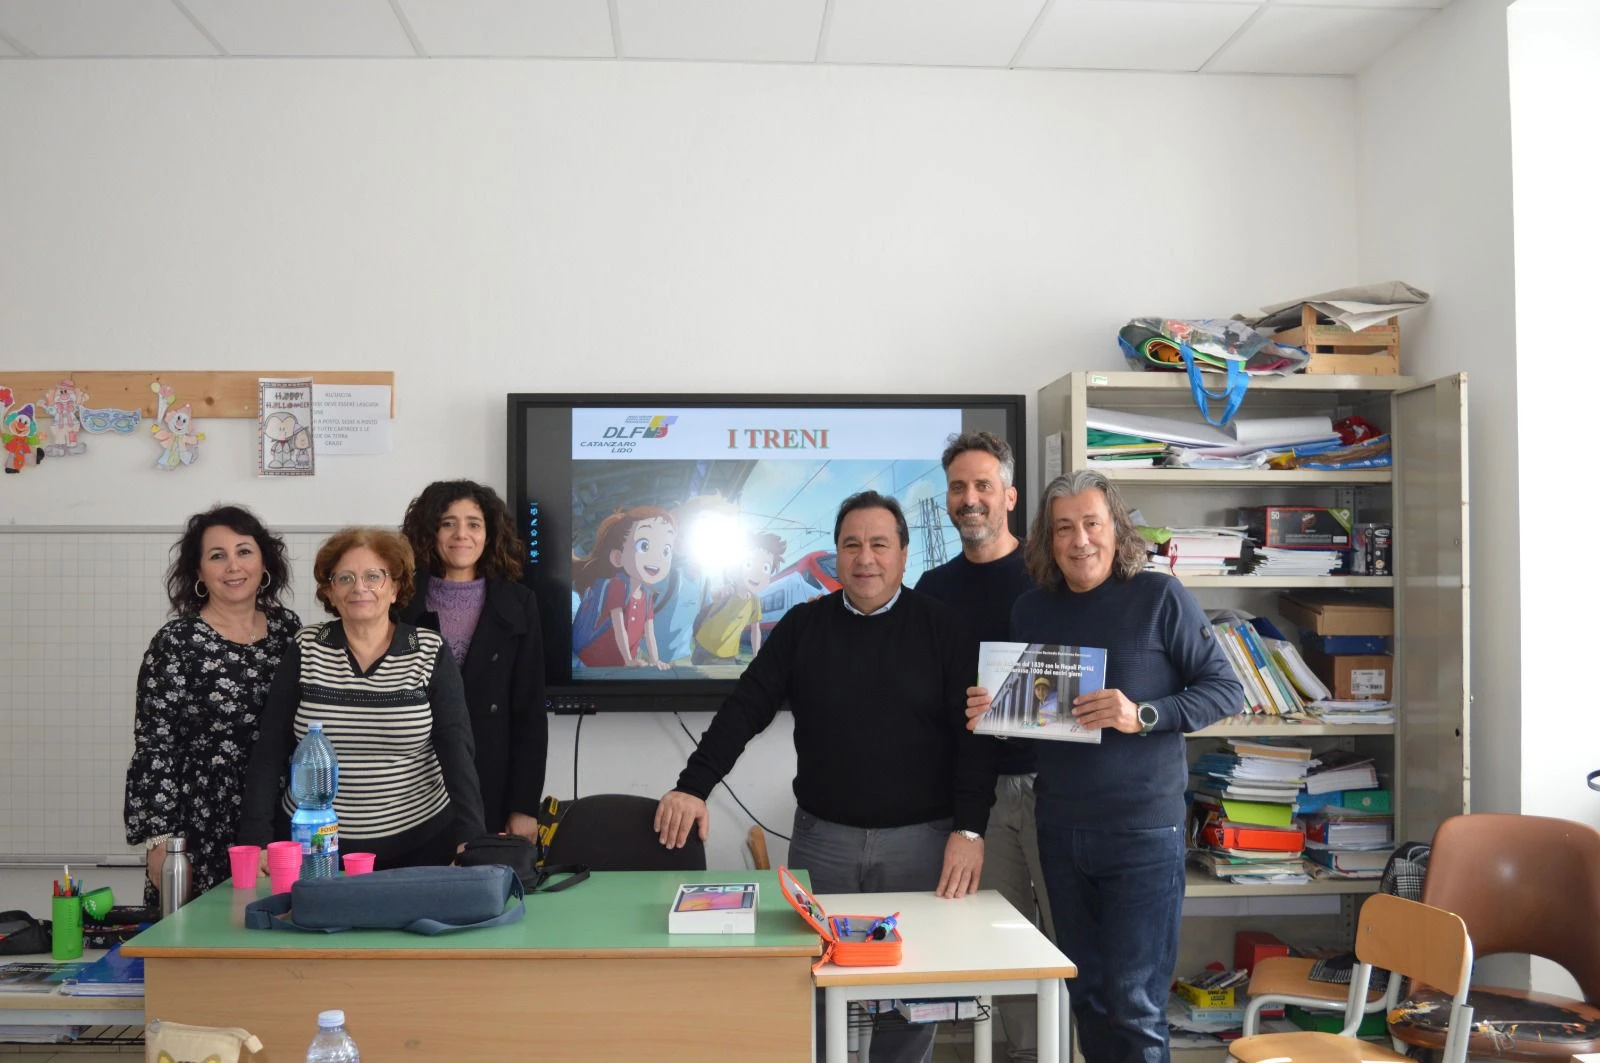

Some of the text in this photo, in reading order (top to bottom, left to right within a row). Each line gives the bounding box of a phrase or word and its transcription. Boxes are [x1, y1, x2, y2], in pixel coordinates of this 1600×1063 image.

[275, 392, 304, 400] HAPPY
[602, 426, 646, 439] DLF
[727, 428, 830, 449] I TRENI
[1270, 511, 1280, 520] 50
